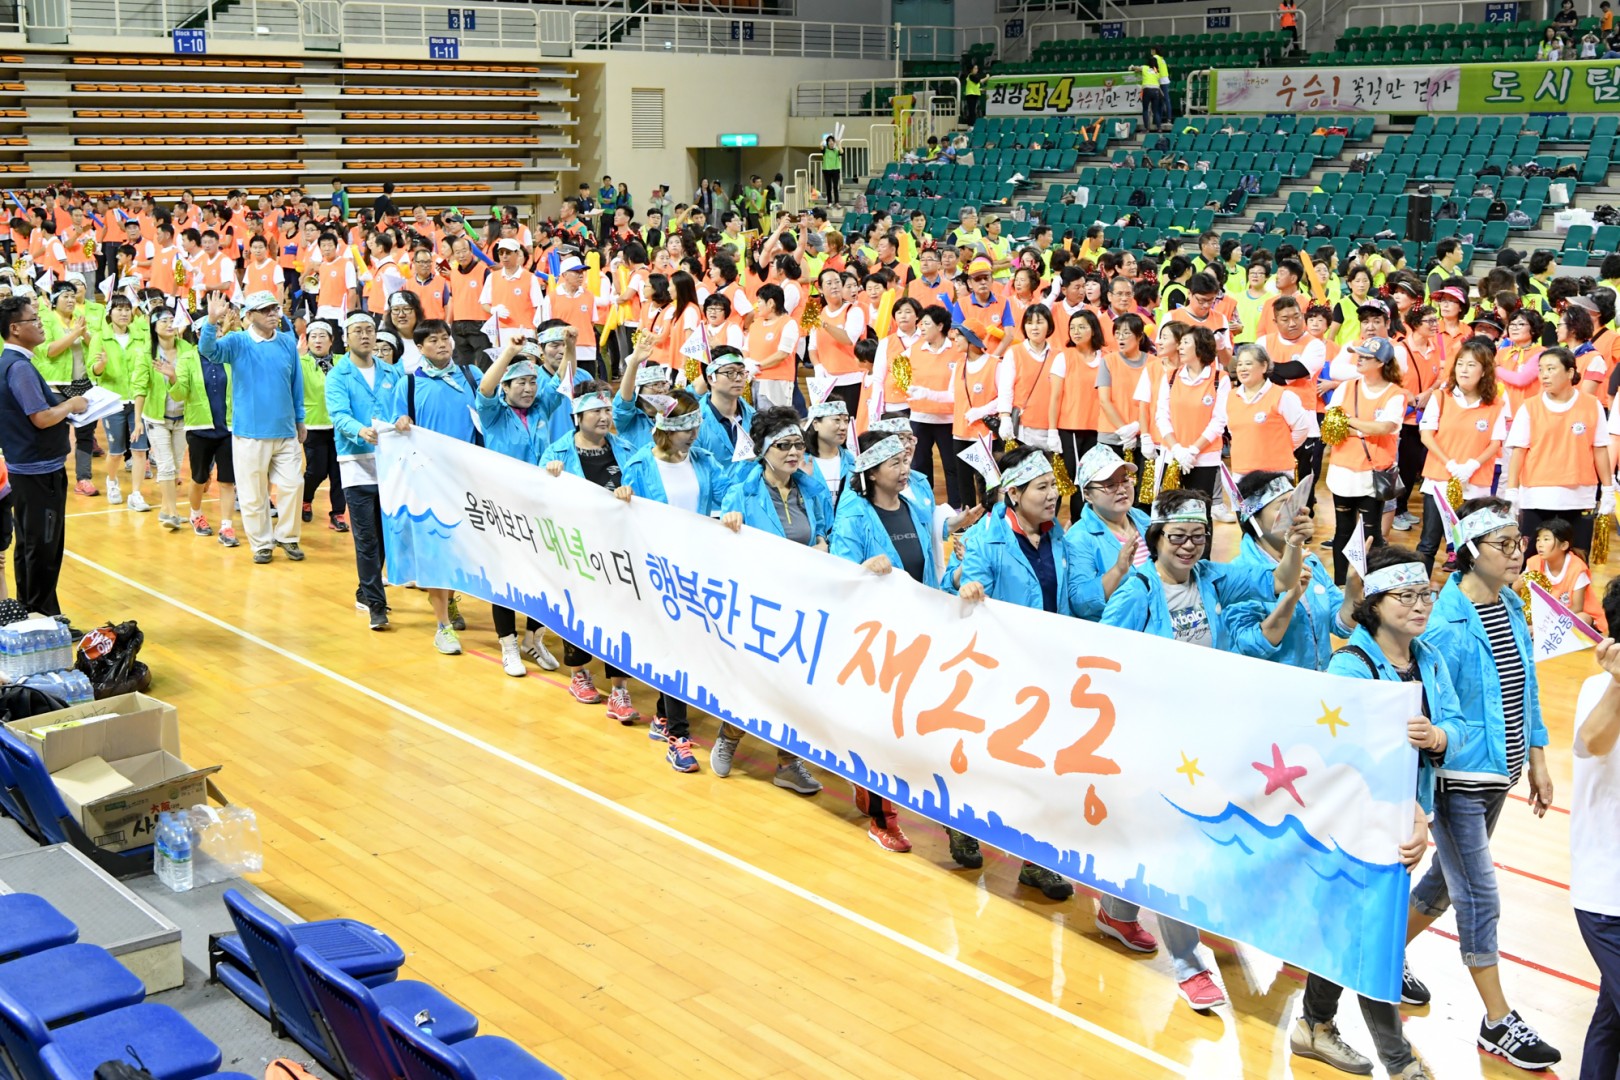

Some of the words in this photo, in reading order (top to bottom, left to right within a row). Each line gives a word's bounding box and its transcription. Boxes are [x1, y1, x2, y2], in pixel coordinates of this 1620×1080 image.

[177, 39, 204, 52] 1-10
[434, 46, 454, 58] 1-11
[991, 82, 1024, 105] 최강
[1276, 74, 1340, 108] 우승!
[1540, 614, 1574, 656] 재송2동
[464, 491, 538, 554] 올해보다
[609, 550, 642, 601] 더
[645, 552, 742, 651] 행복한
[744, 594, 830, 686] 도시
[836, 620, 1122, 827] 재송2동
